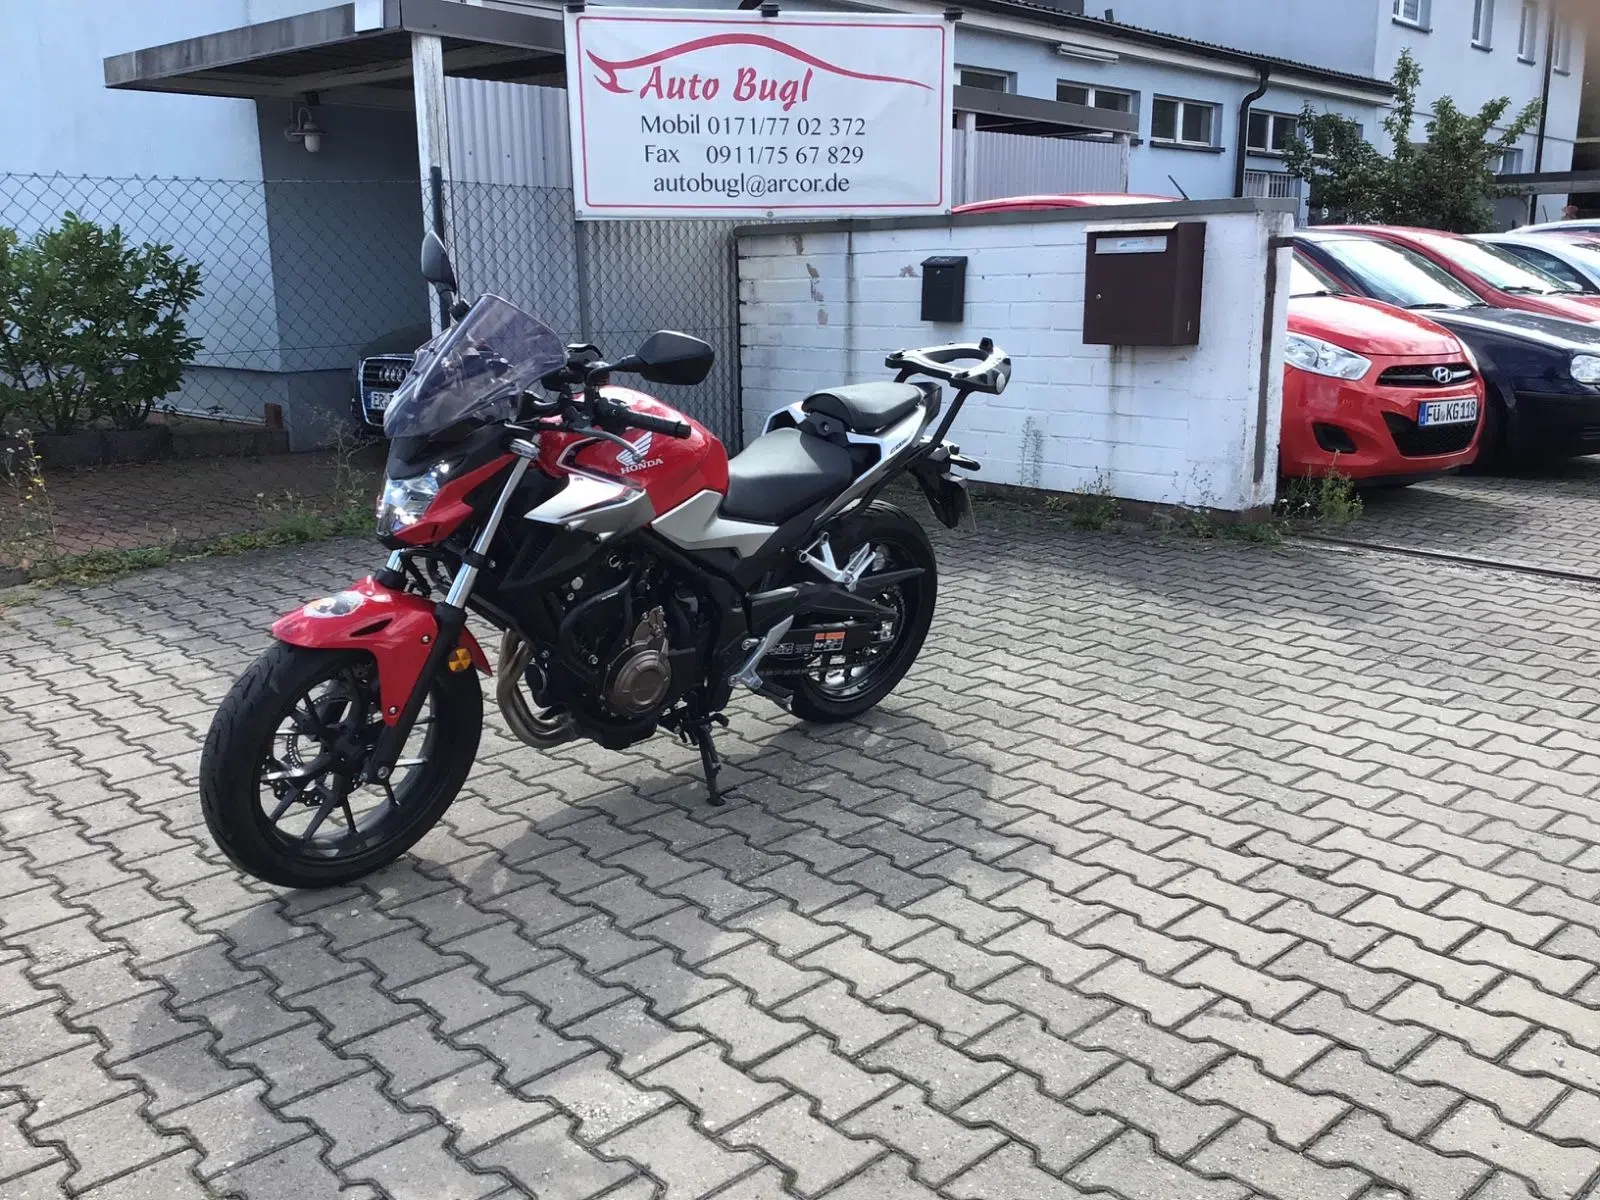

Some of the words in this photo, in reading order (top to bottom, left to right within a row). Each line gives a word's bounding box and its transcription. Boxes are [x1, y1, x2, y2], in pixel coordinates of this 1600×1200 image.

[639, 65, 719, 101] Auto
[733, 67, 813, 112] Bugl
[640, 114, 701, 135] Mobil
[707, 117, 789, 136] 0171/77
[797, 118, 822, 136] 02
[829, 118, 866, 136] 372
[644, 145, 681, 163] Fax
[706, 146, 788, 165] 0911/75
[795, 146, 820, 164] 67
[826, 146, 864, 164] 829
[653, 172, 850, 198] autobugl@arcor.de
[1426, 404, 1440, 423] FÜ
[620, 457, 664, 475] HONDA
